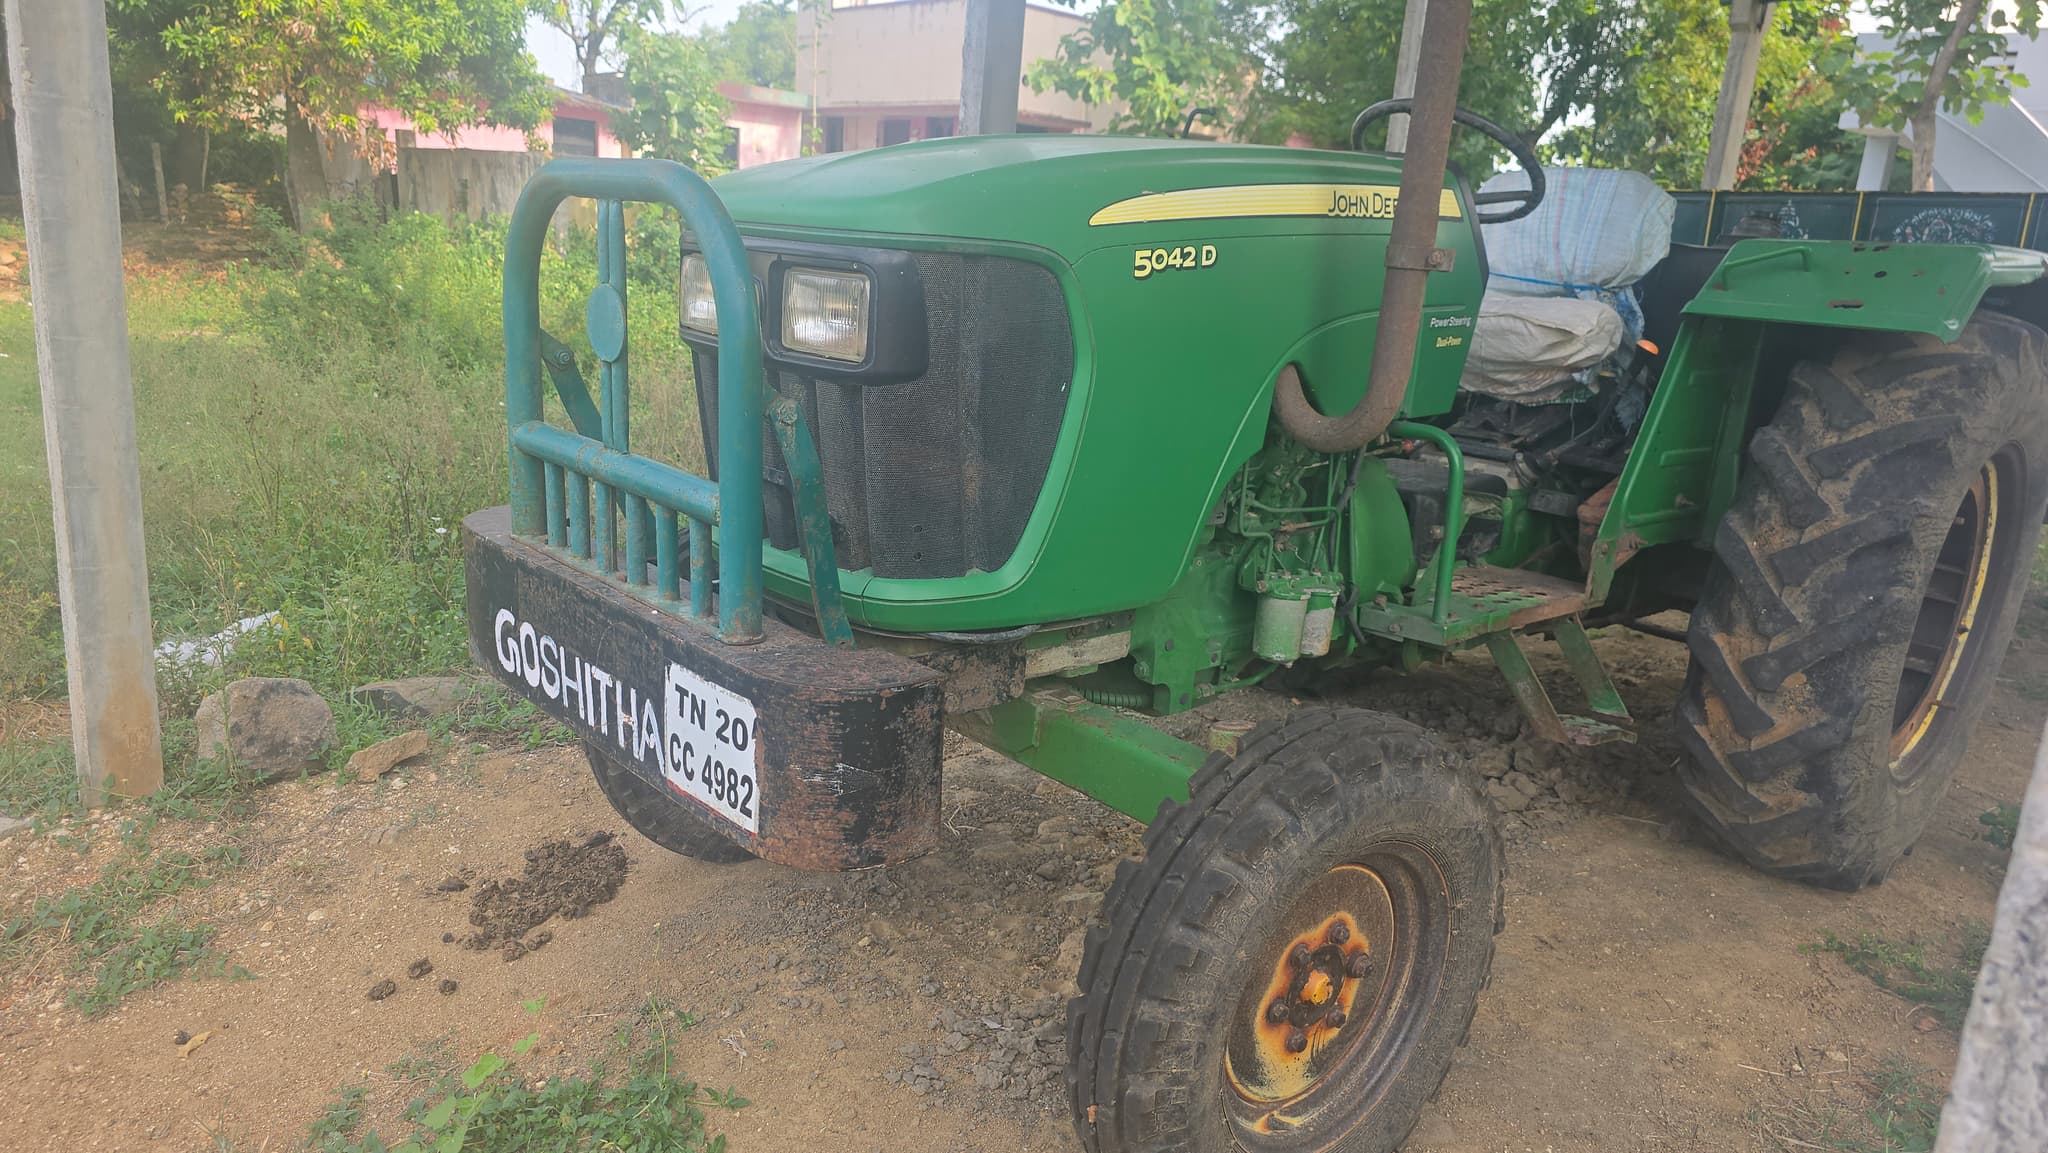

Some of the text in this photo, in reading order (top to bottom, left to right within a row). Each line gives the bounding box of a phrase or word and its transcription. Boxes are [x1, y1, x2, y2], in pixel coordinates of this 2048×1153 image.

[1328, 190, 1369, 214] JOHN
[1133, 243, 1218, 279] 5042 D
[495, 608, 666, 776] GOSHITHA
[674, 683, 749, 752] TN 20
[669, 732, 754, 820] CC 4982
